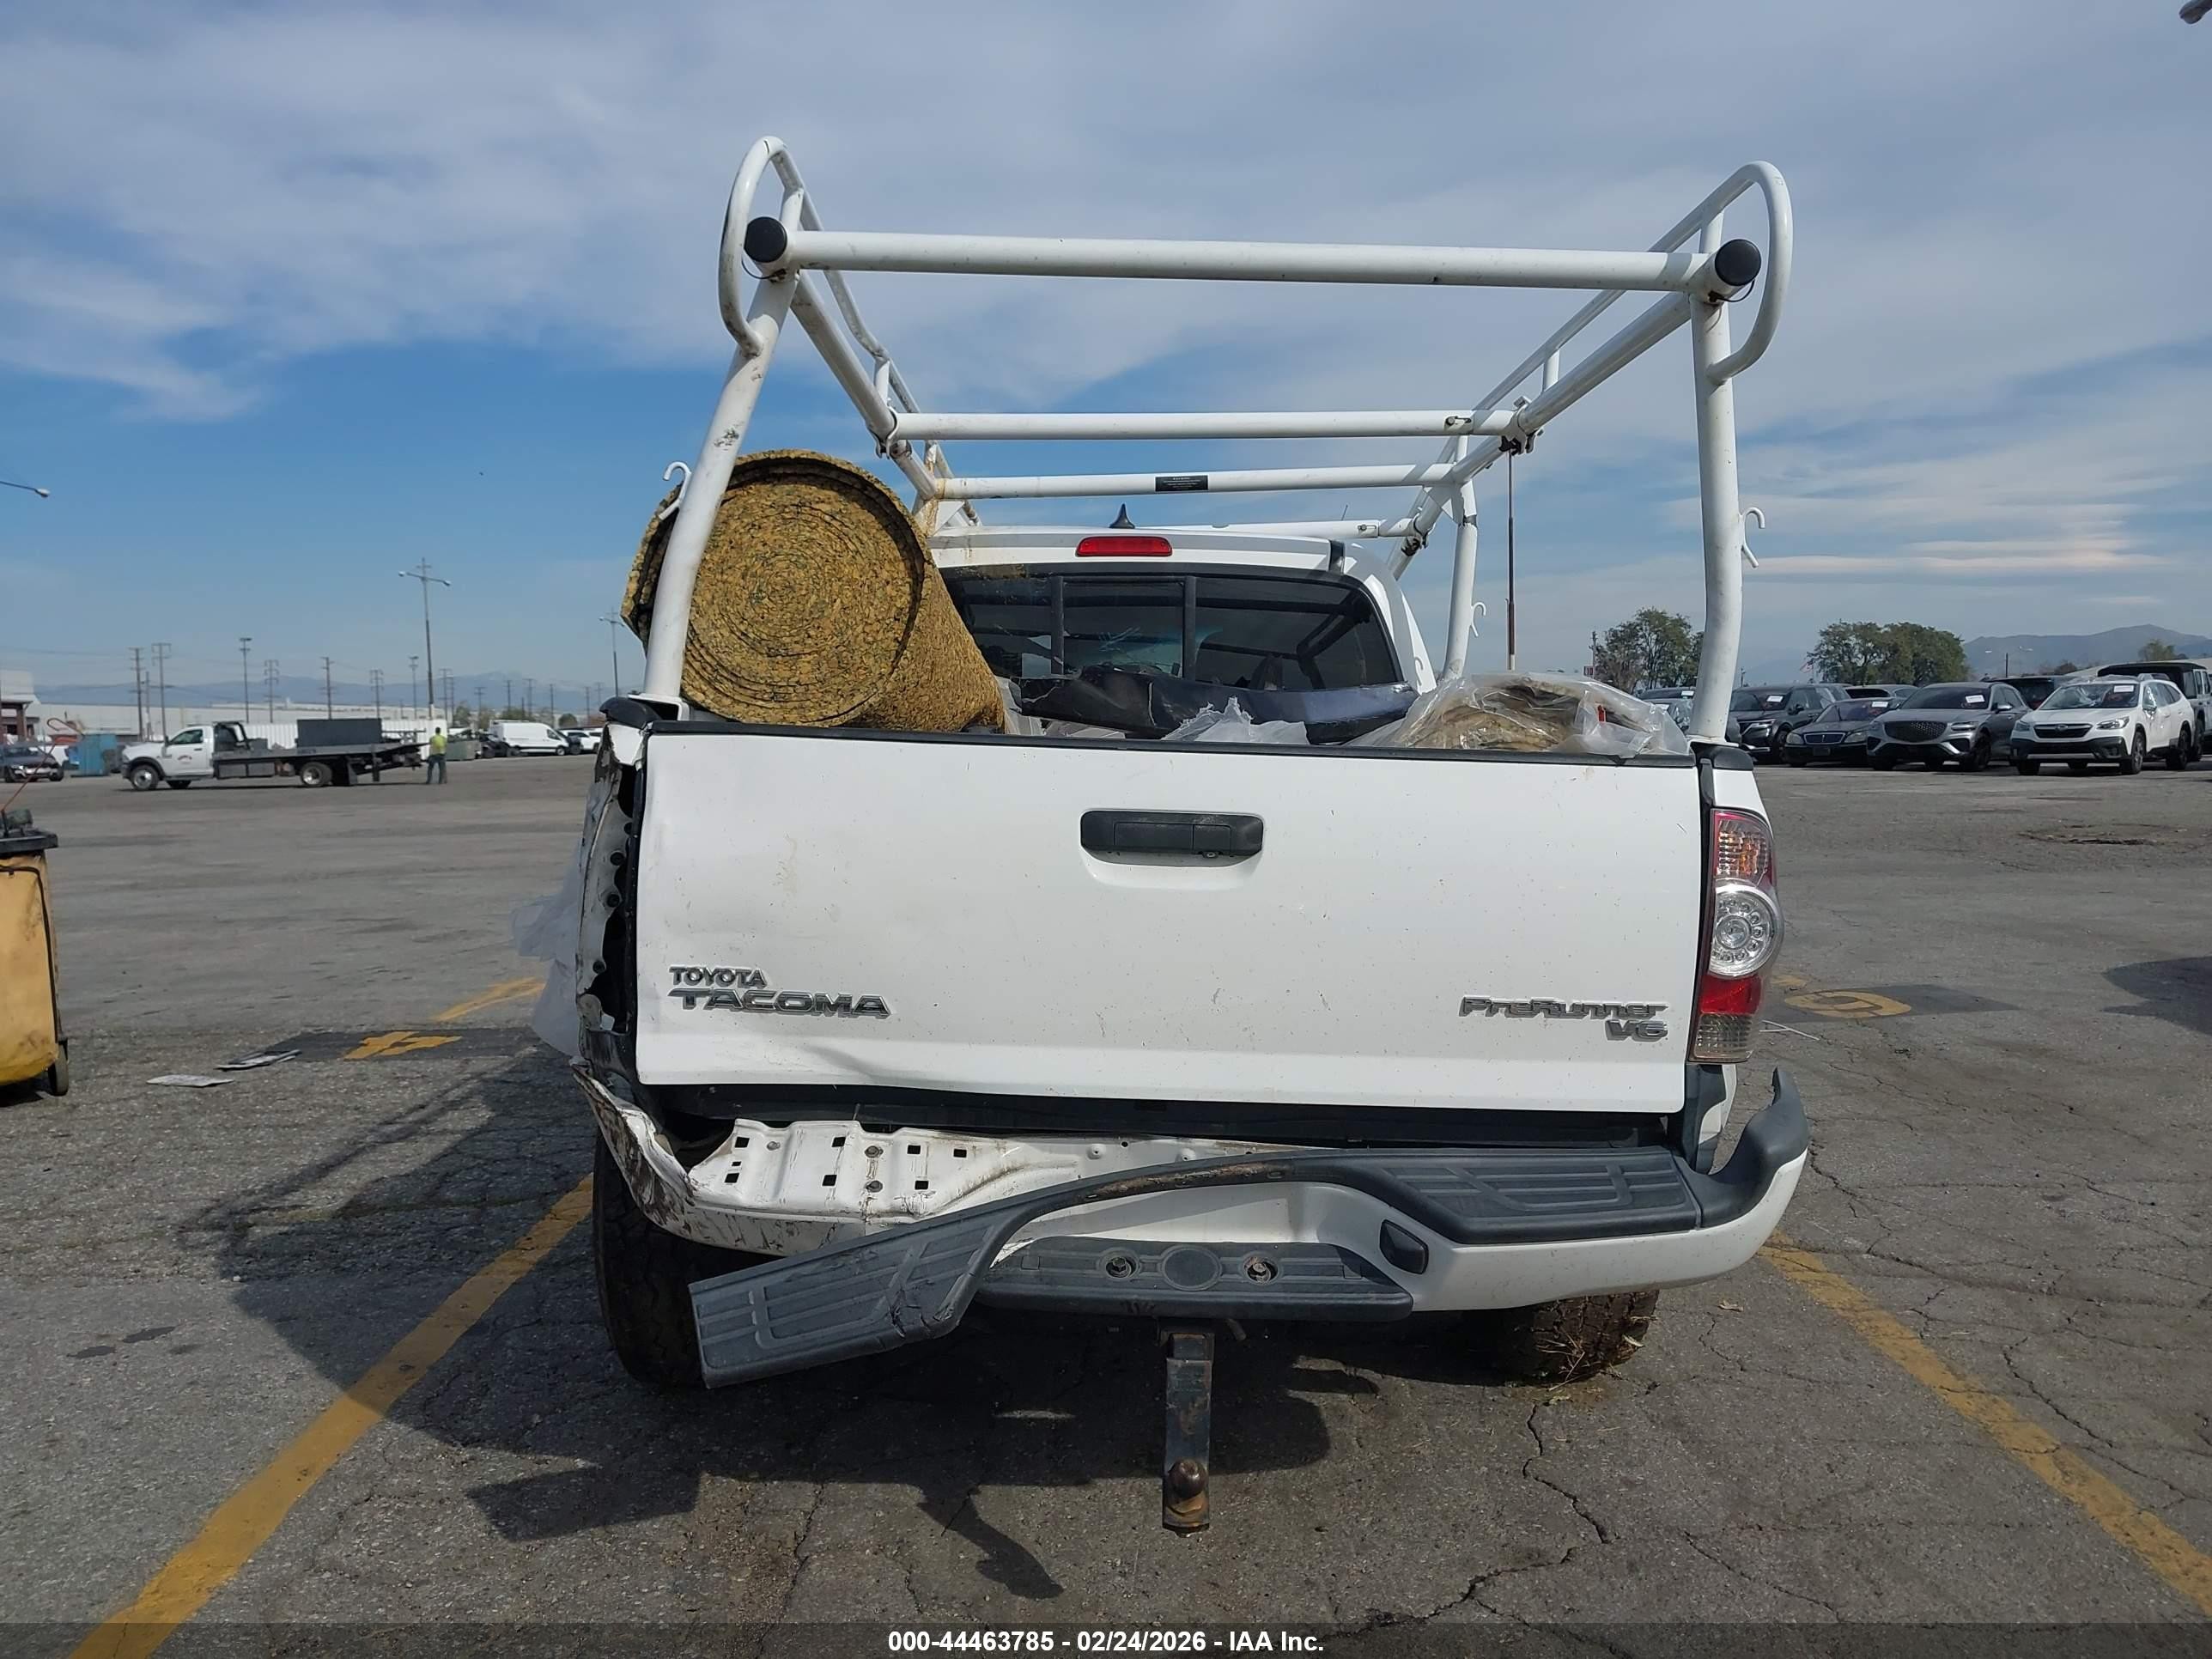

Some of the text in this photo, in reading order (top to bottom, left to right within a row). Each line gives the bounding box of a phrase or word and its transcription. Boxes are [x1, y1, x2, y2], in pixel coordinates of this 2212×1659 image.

[669, 966, 768, 988] TOYOTA
[667, 988, 891, 1019] TACOMA
[1604, 1019, 1668, 1042] V6
